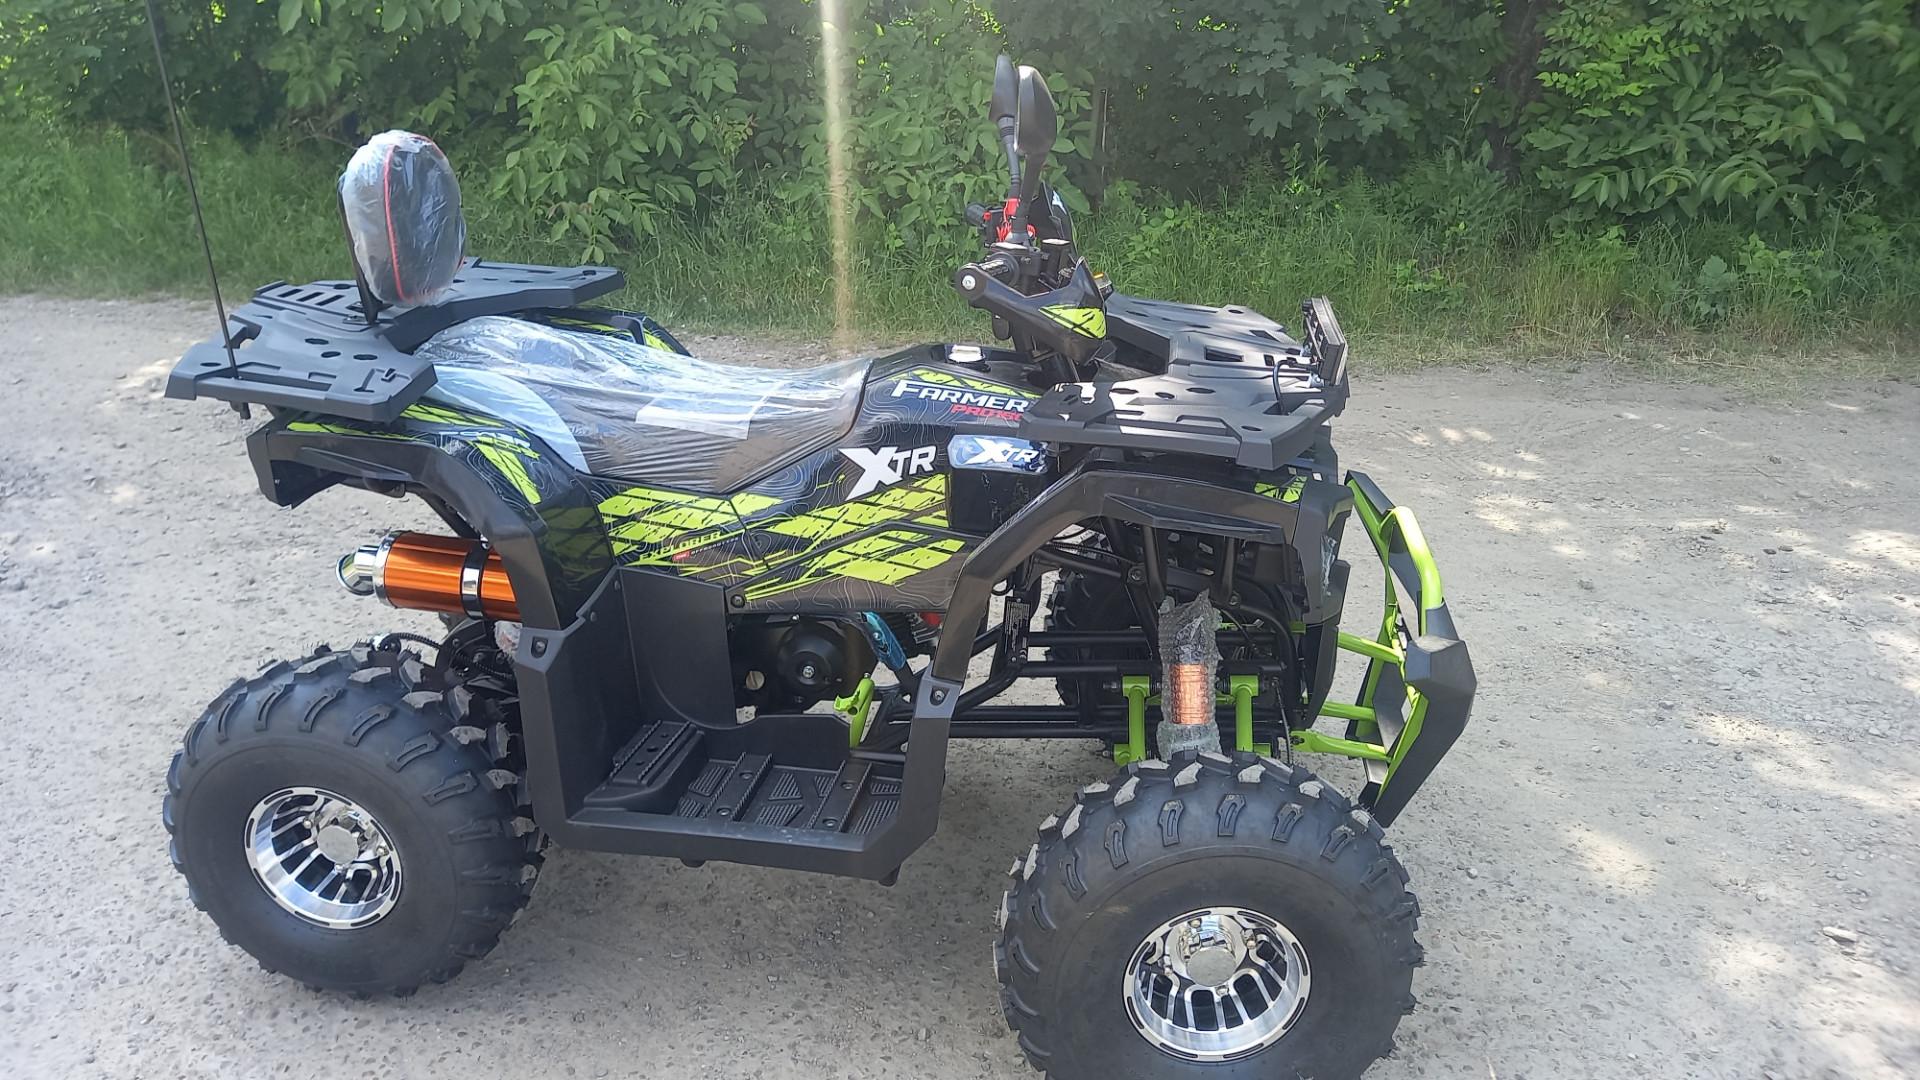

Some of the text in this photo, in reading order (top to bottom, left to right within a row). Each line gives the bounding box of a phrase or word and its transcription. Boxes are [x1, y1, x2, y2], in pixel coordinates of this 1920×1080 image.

[890, 379, 1029, 413] FARMER
[963, 437, 1040, 465] XTR
[838, 445, 937, 502] XTR
